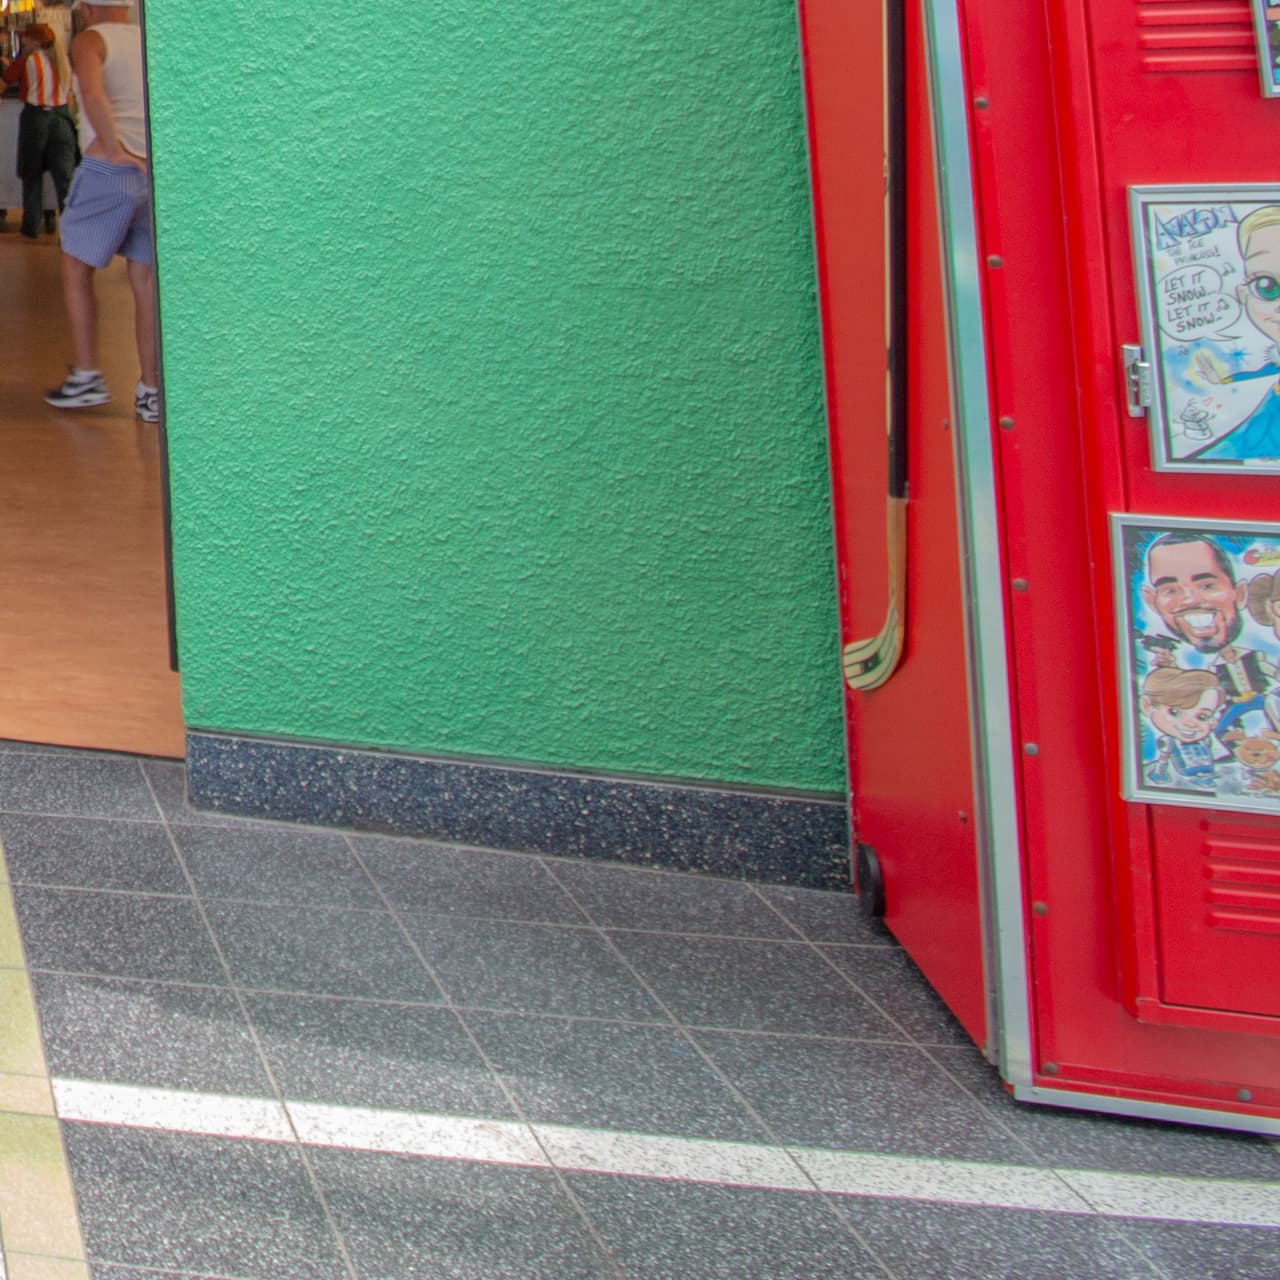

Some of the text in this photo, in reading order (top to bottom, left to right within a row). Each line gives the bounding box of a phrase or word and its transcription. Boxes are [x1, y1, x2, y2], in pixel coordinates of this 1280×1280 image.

[1164, 269, 1206, 293] LET IT
[1166, 301, 1210, 323] LET IT
